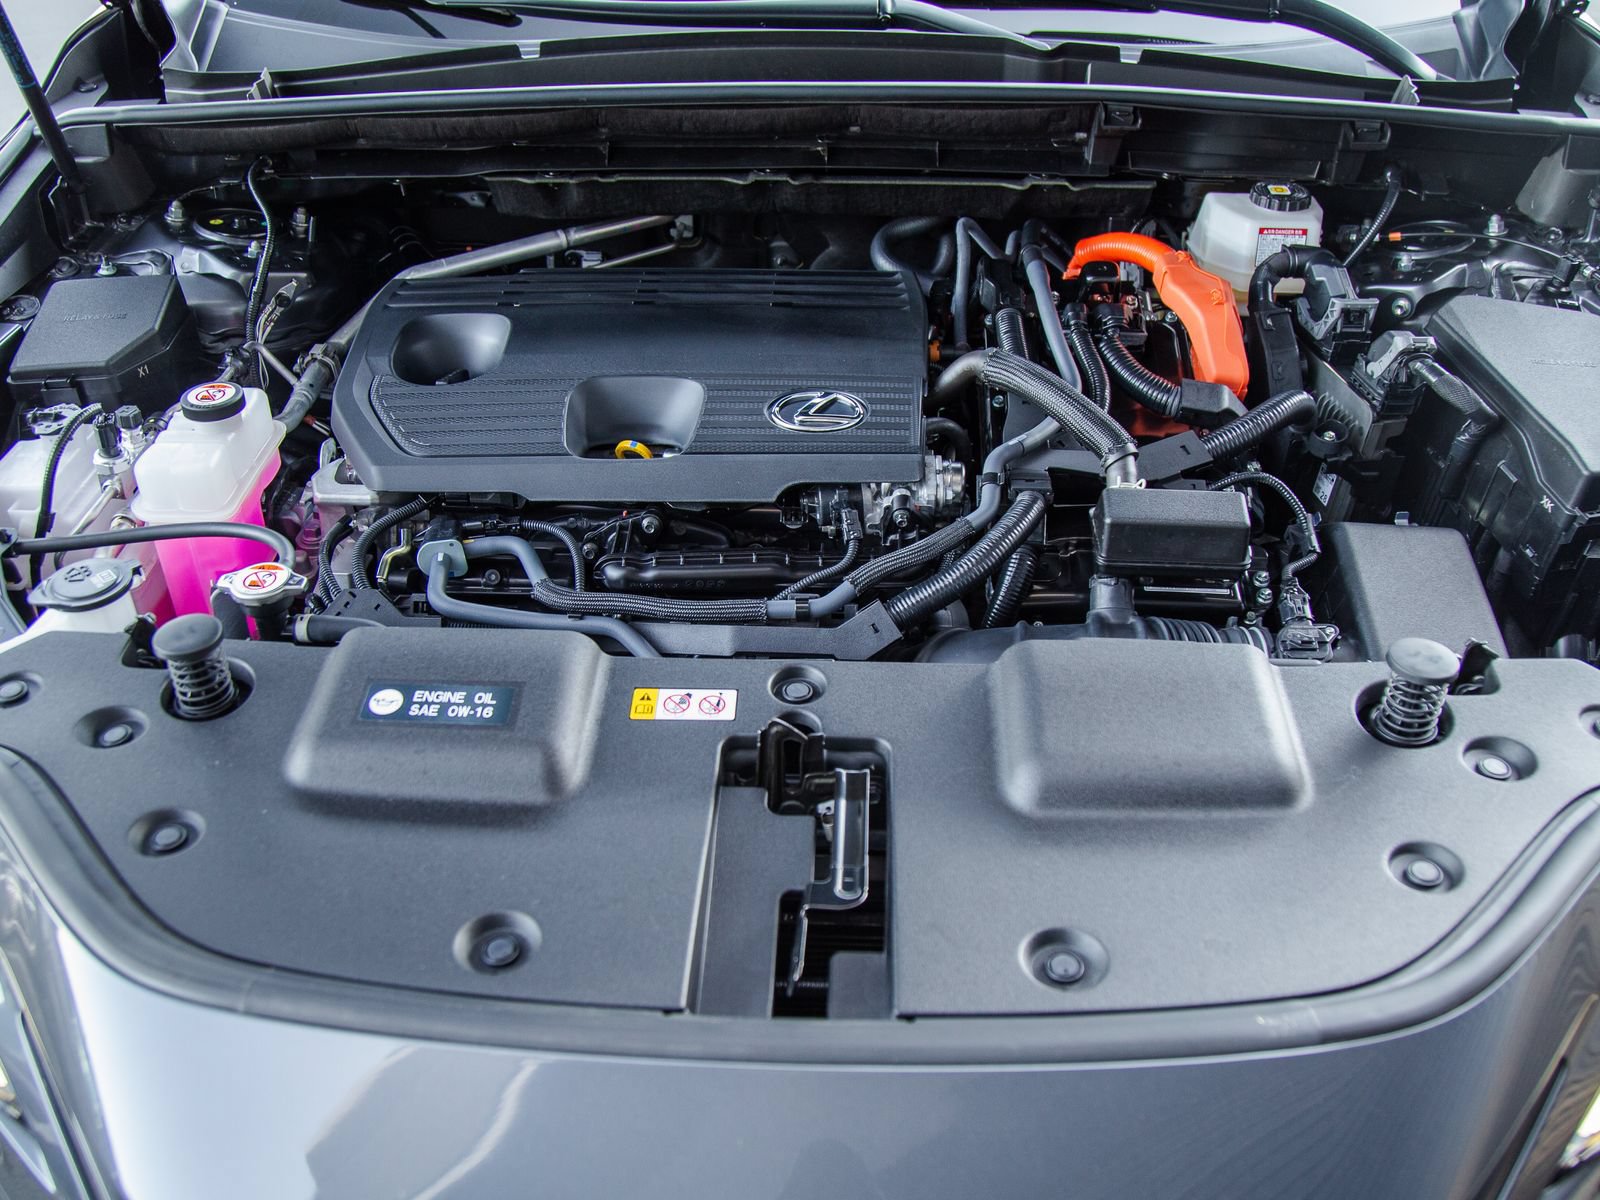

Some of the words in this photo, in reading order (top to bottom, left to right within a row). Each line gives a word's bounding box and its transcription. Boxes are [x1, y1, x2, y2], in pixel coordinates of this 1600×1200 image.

[137, 364, 149, 378] X1
[412, 690, 467, 704] ENGINE
[474, 691, 497, 705] OIL
[409, 704, 441, 717] SAE
